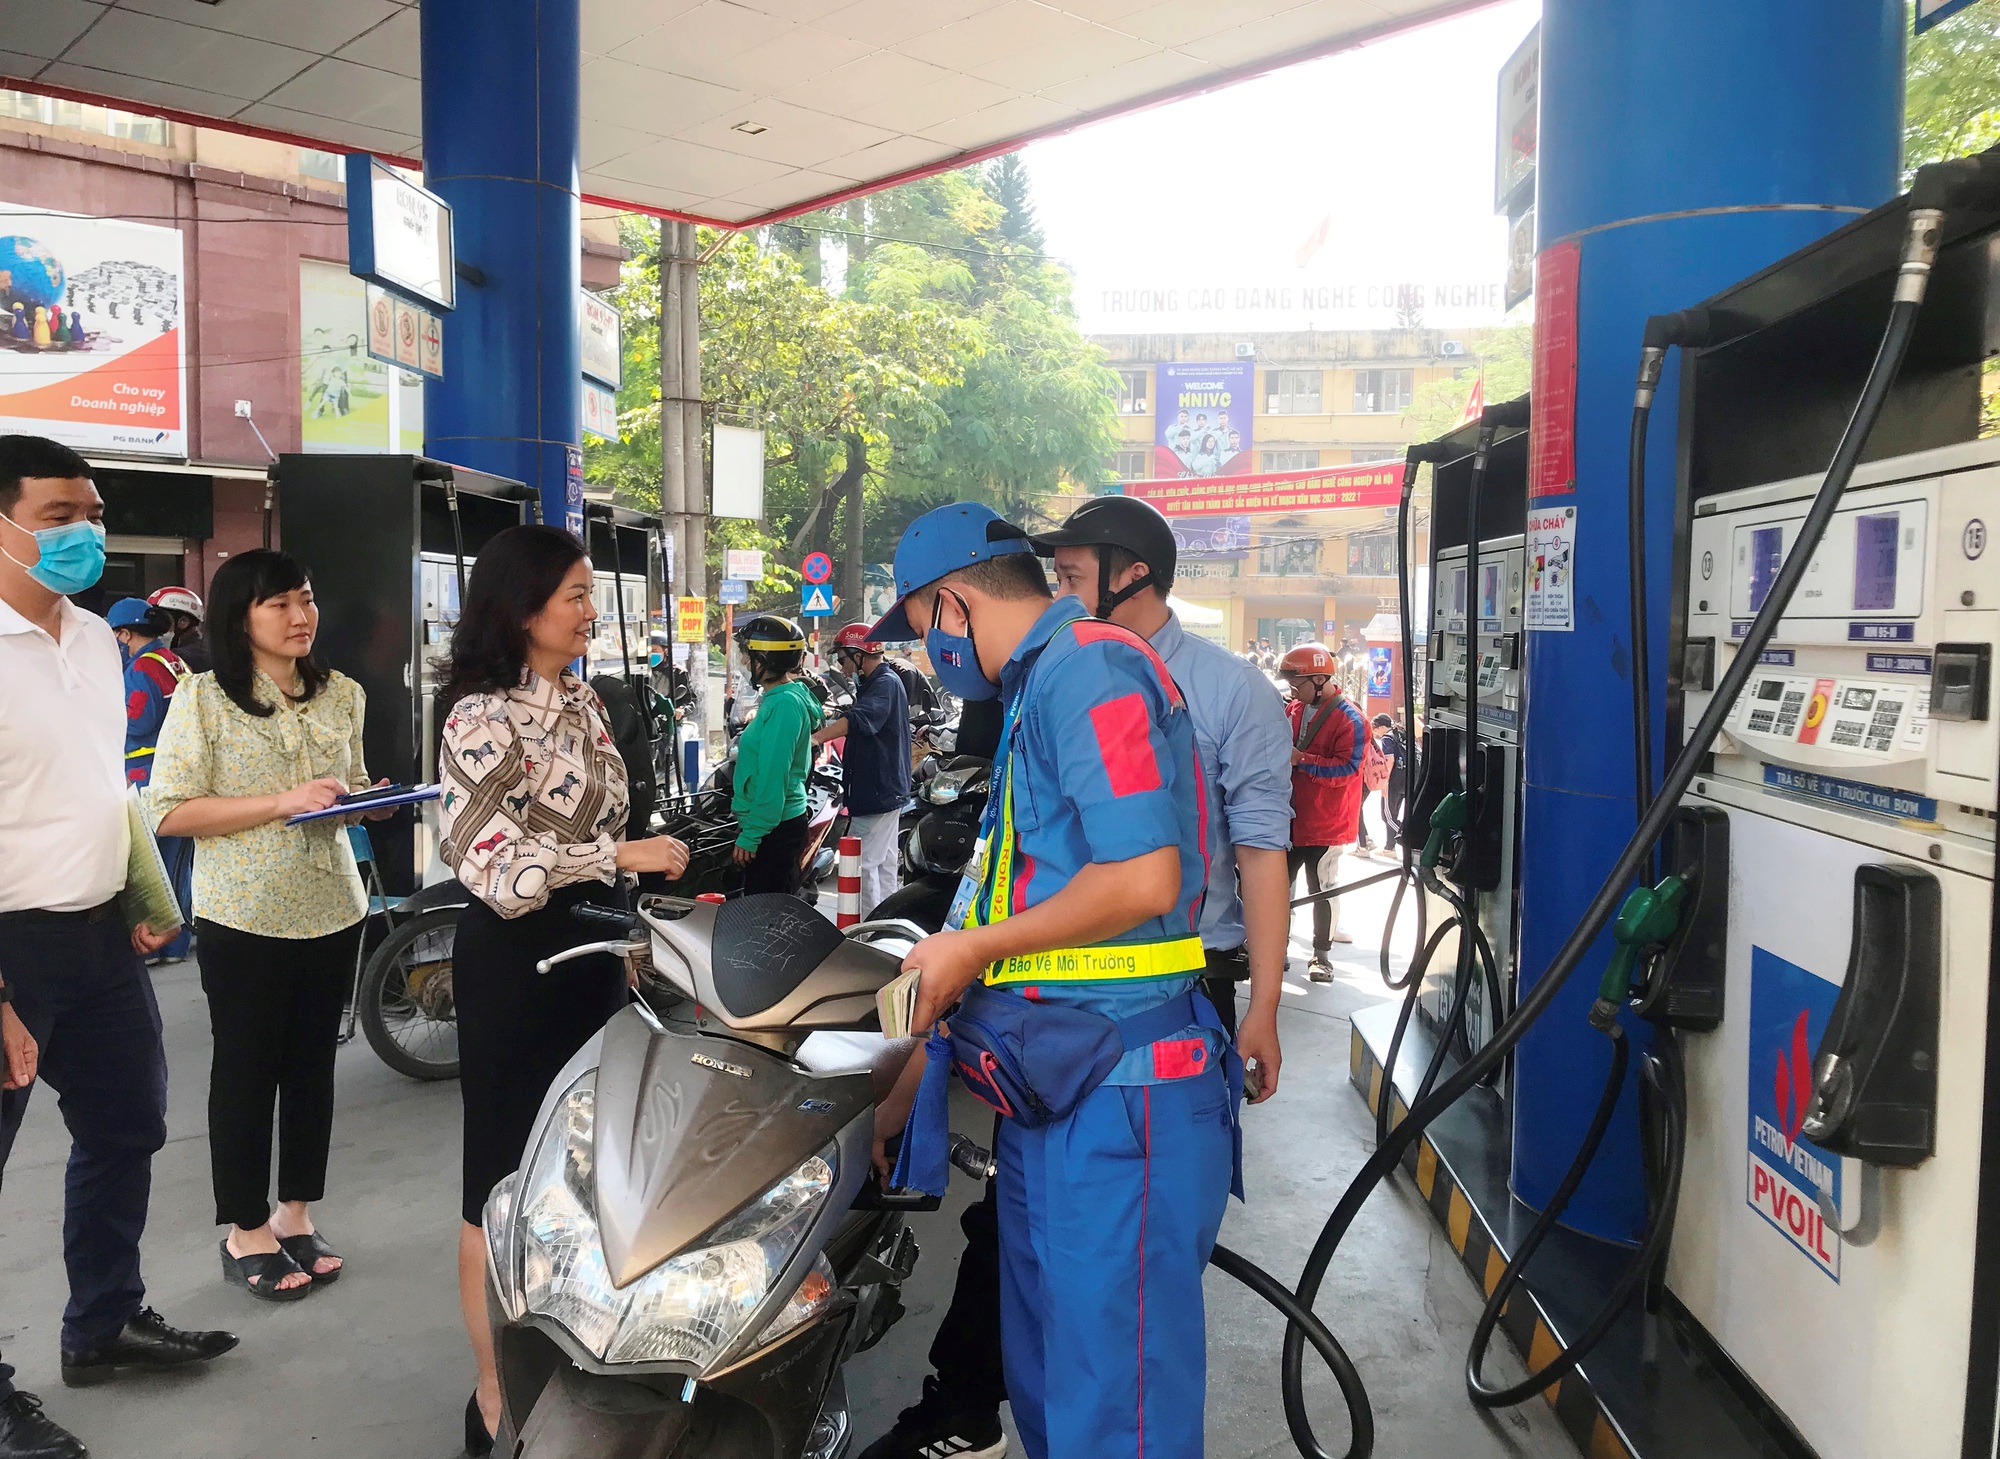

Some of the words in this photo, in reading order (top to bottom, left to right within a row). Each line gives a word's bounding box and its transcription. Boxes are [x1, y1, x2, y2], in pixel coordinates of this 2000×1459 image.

[1188, 288, 1226, 311] CAO
[113, 383, 139, 396] Cho
[142, 388, 165, 400] vay
[1185, 382, 1225, 390] WELCOME
[70, 396, 117, 411] Doanh
[120, 400, 166, 417] nghiệp
[1178, 392, 1231, 407] HNIVC
[128, 437, 155, 445] BANK
[1337, 476, 1351, 488] CÔNG
[1353, 473, 1372, 487] NGHIỆP
[1374, 472, 1381, 485] HÀ
[1383, 472, 1393, 485] NỘI
[1322, 493, 1336, 503] 2021
[1341, 492, 1356, 502] 2022
[1543, 514, 1566, 530] CHÁY
[1968, 528, 1983, 549] 15
[1704, 558, 1711, 573] 13
[735, 584, 743, 592] 192
[680, 601, 703, 613] PHOTO
[682, 618, 701, 630] COPY
[994, 765, 1002, 778] NỘI
[1776, 771, 1792, 786] TRẢ
[1793, 773, 1806, 788] SỐ
[1807, 776, 1818, 792] VỀ
[1837, 786, 1870, 804] TRƯỚC
[1872, 794, 1890, 808] KHI
[1893, 798, 1919, 816] BƠM
[1005, 821, 1012, 843] E5
[998, 848, 1010, 888] RON
[993, 894, 1004, 915] 92
[1009, 953, 1031, 973] Bảo
[1035, 954, 1052, 975] Vệ
[1056, 955, 1078, 972] Môi
[1083, 953, 1136, 973] Trường
[690, 1052, 754, 1080] HONDA
[1754, 1114, 1834, 1198] PETROVIETNAM
[1754, 1163, 1831, 1264] PVOIL
